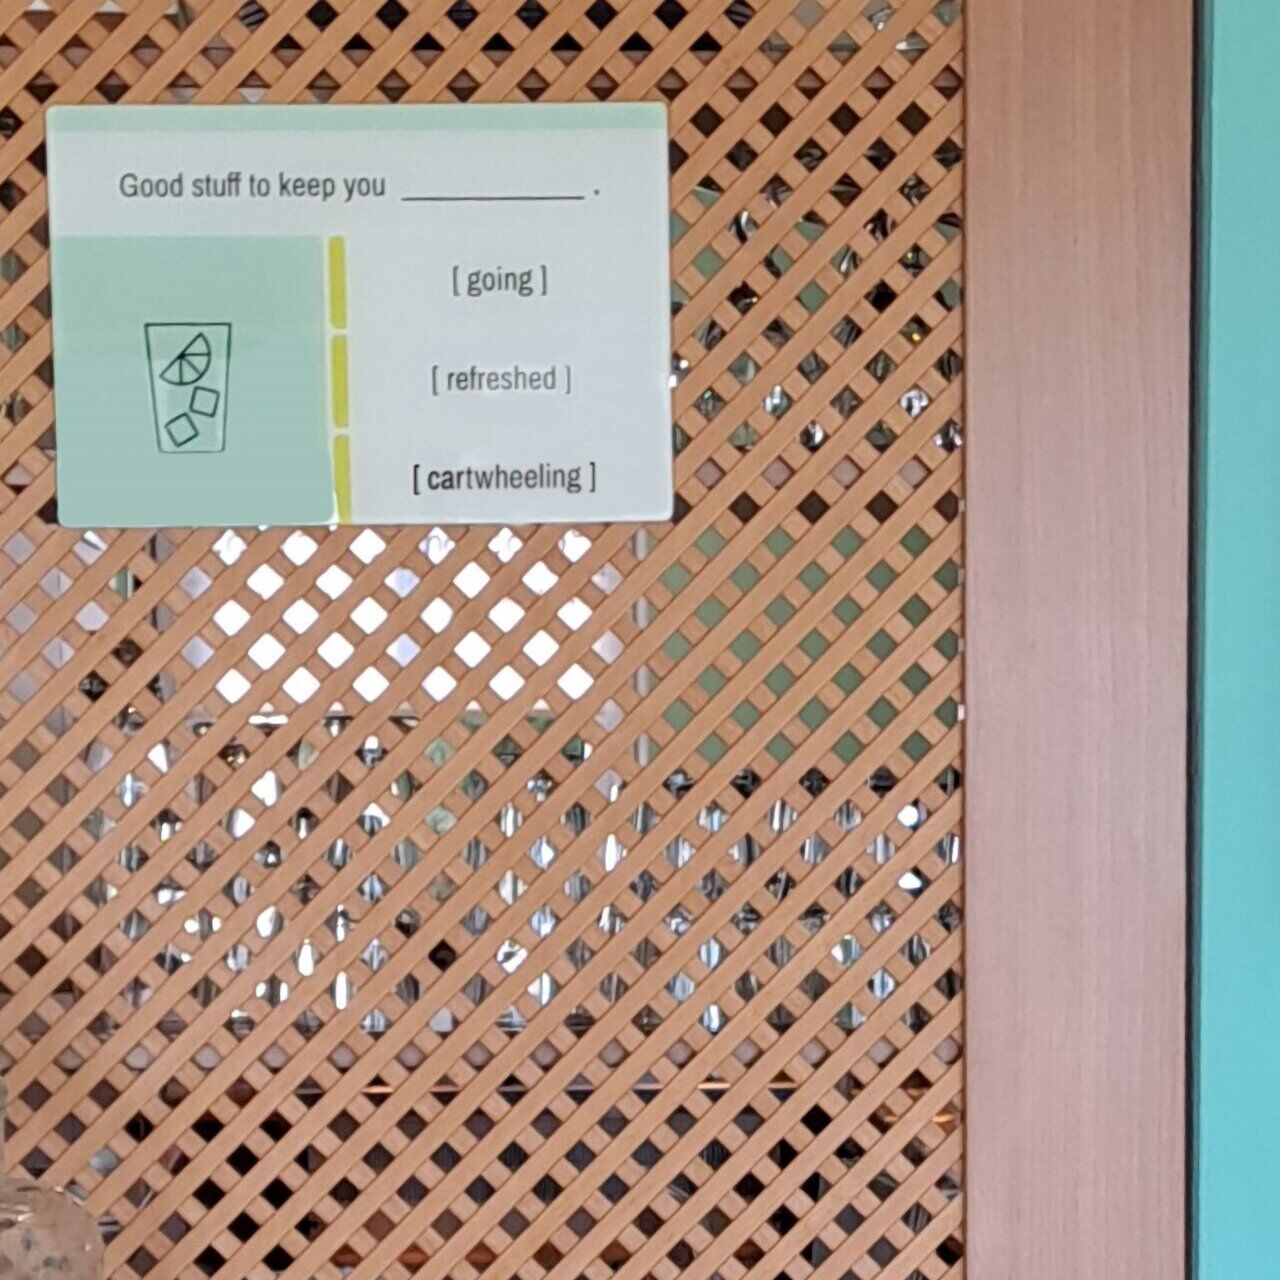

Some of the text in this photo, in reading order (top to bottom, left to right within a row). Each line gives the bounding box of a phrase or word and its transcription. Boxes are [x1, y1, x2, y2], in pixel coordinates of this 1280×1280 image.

[119, 171, 387, 203] Good stuff to keep you
